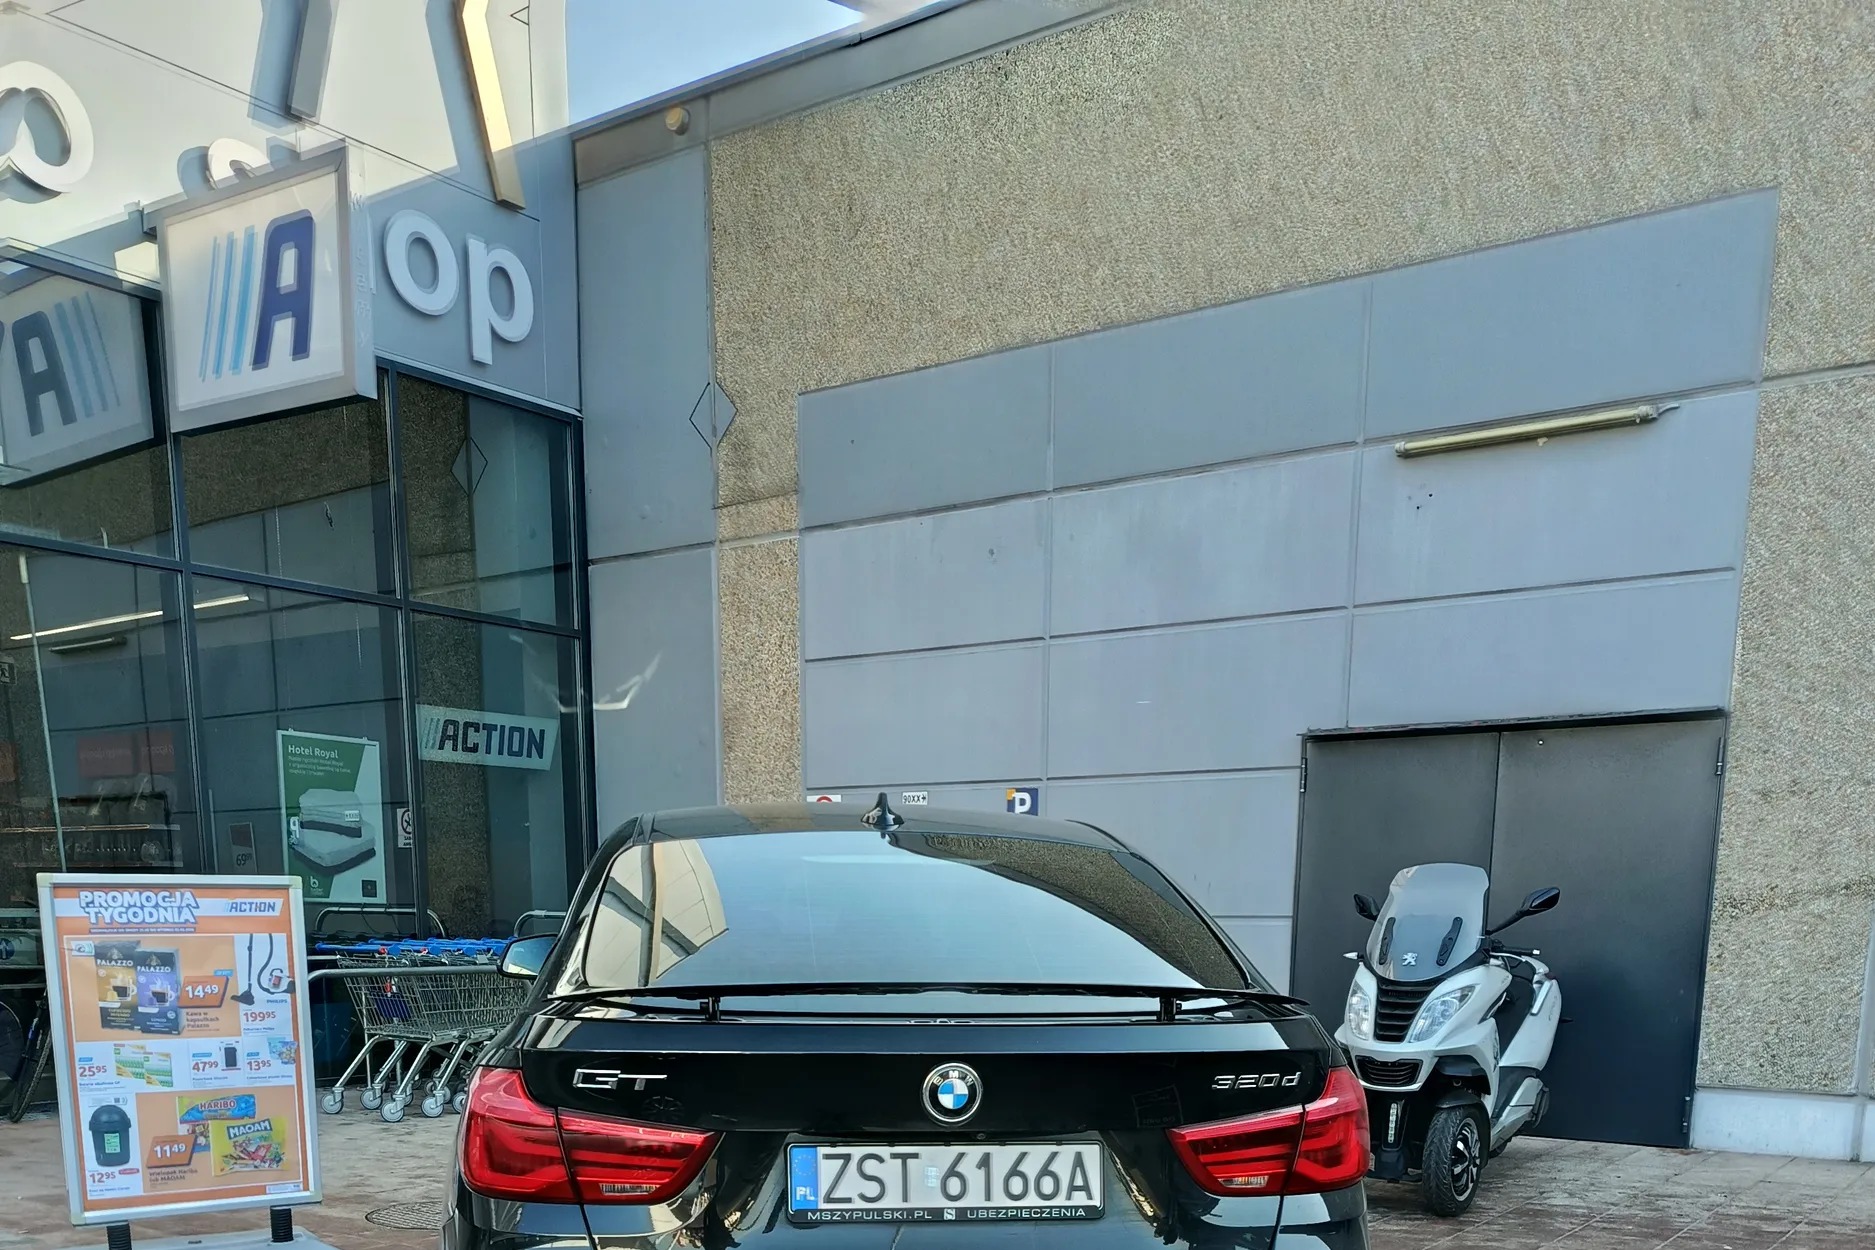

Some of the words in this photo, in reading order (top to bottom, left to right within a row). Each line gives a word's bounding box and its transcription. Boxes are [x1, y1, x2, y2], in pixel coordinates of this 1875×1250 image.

[252, 208, 316, 371] A
[437, 719, 546, 760] ACTION
[288, 744, 313, 756] Hotel
[314, 747, 339, 759] Royal
[1014, 792, 1032, 814] P
[79, 890, 199, 908] PROMOCJA
[229, 901, 276, 913] ACTION
[84, 906, 197, 925] TYGODNIA
[96, 959, 134, 967] PALAZZO
[572, 1068, 668, 1091] GT
[932, 1069, 974, 1087] BMW
[1211, 1071, 1302, 1090] 320d
[199, 1100, 236, 1110] HARIBO
[229, 1120, 271, 1138] MAOAM
[821, 1152, 920, 1204] ZST
[939, 1150, 1094, 1202] 6166A
[795, 1186, 815, 1201] PL
[807, 1209, 933, 1221] MSZYPULSKI.PL
[967, 1208, 1087, 1219] UBEZPIECZENIA
